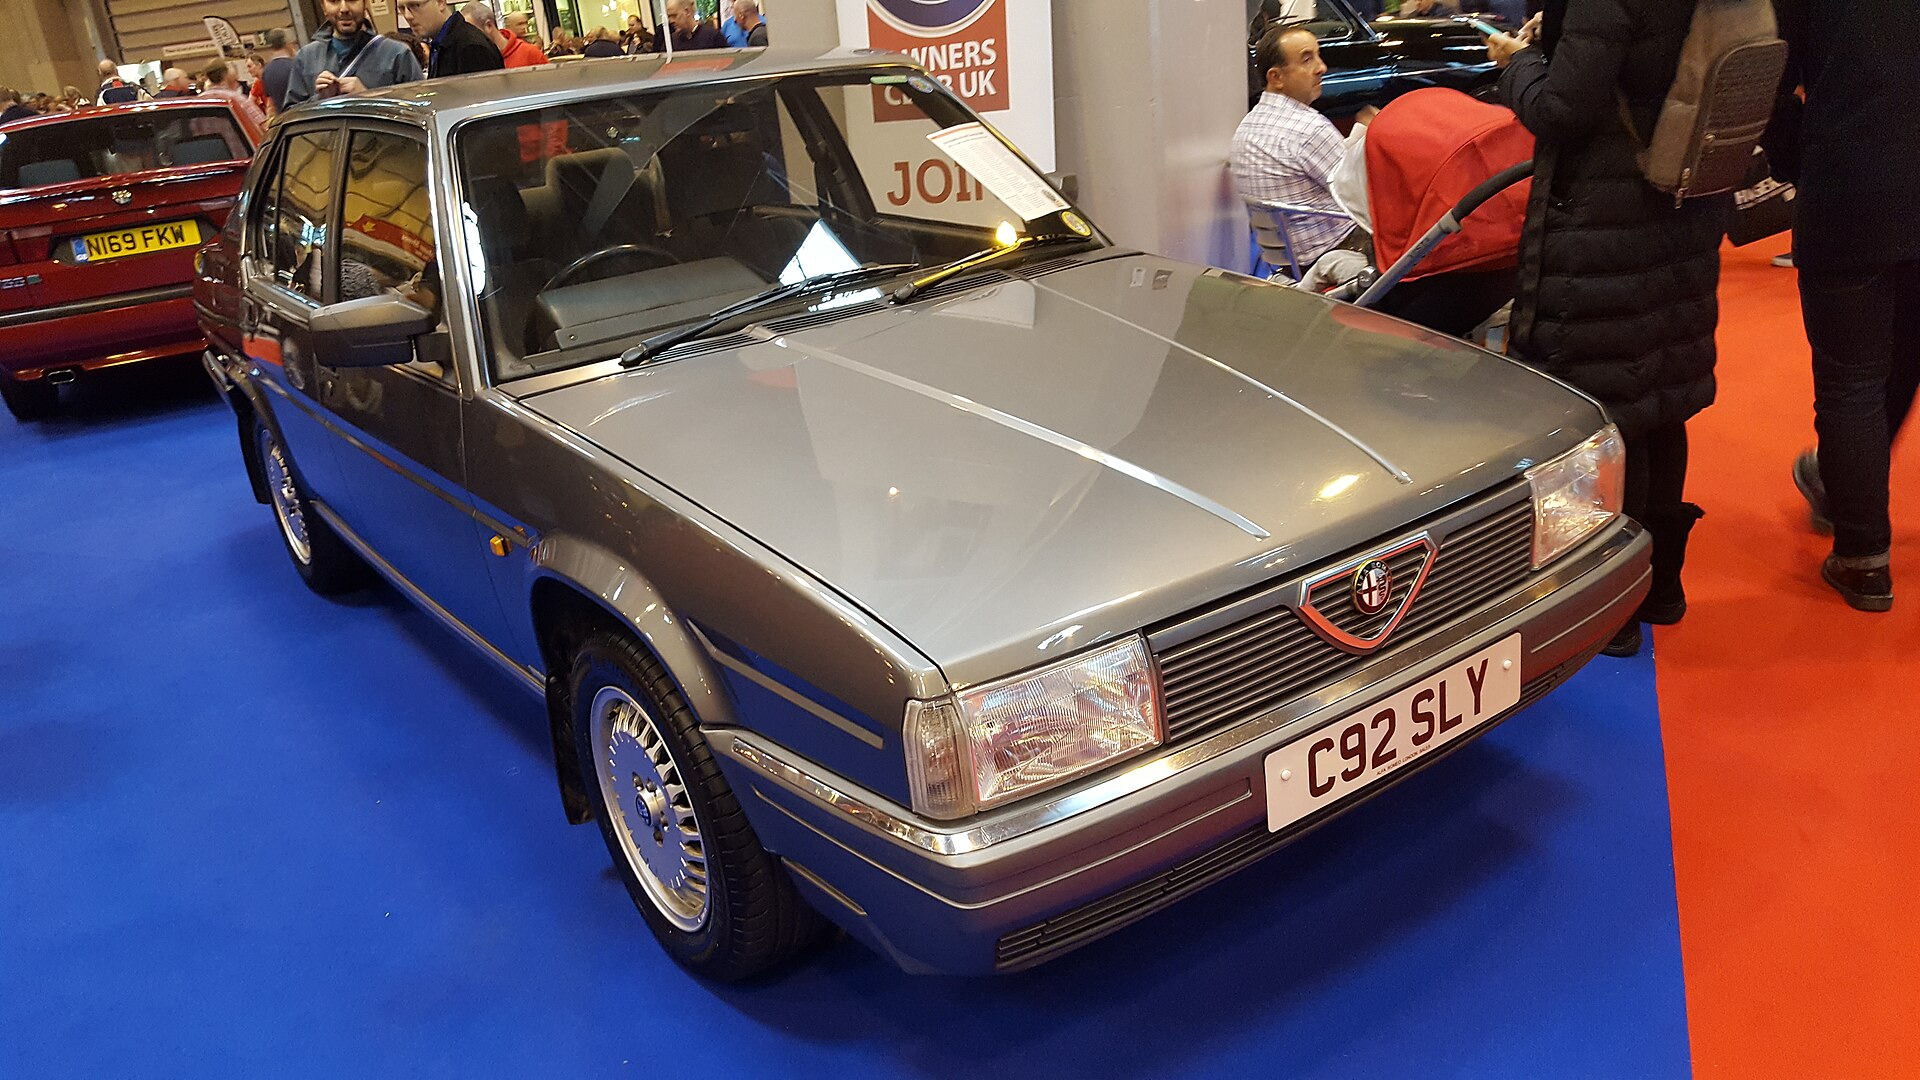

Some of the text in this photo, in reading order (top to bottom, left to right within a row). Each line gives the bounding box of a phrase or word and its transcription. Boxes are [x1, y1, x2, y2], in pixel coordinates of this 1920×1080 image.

[901, 38, 998, 71] WNERS
[959, 69, 997, 98] UK
[886, 158, 984, 206] JOI
[86, 224, 185, 257] N169 FKW
[1307, 658, 1489, 798] C92 SLY
[1387, 760, 1401, 770] ROMEO
[1402, 752, 1418, 762] LONDON
